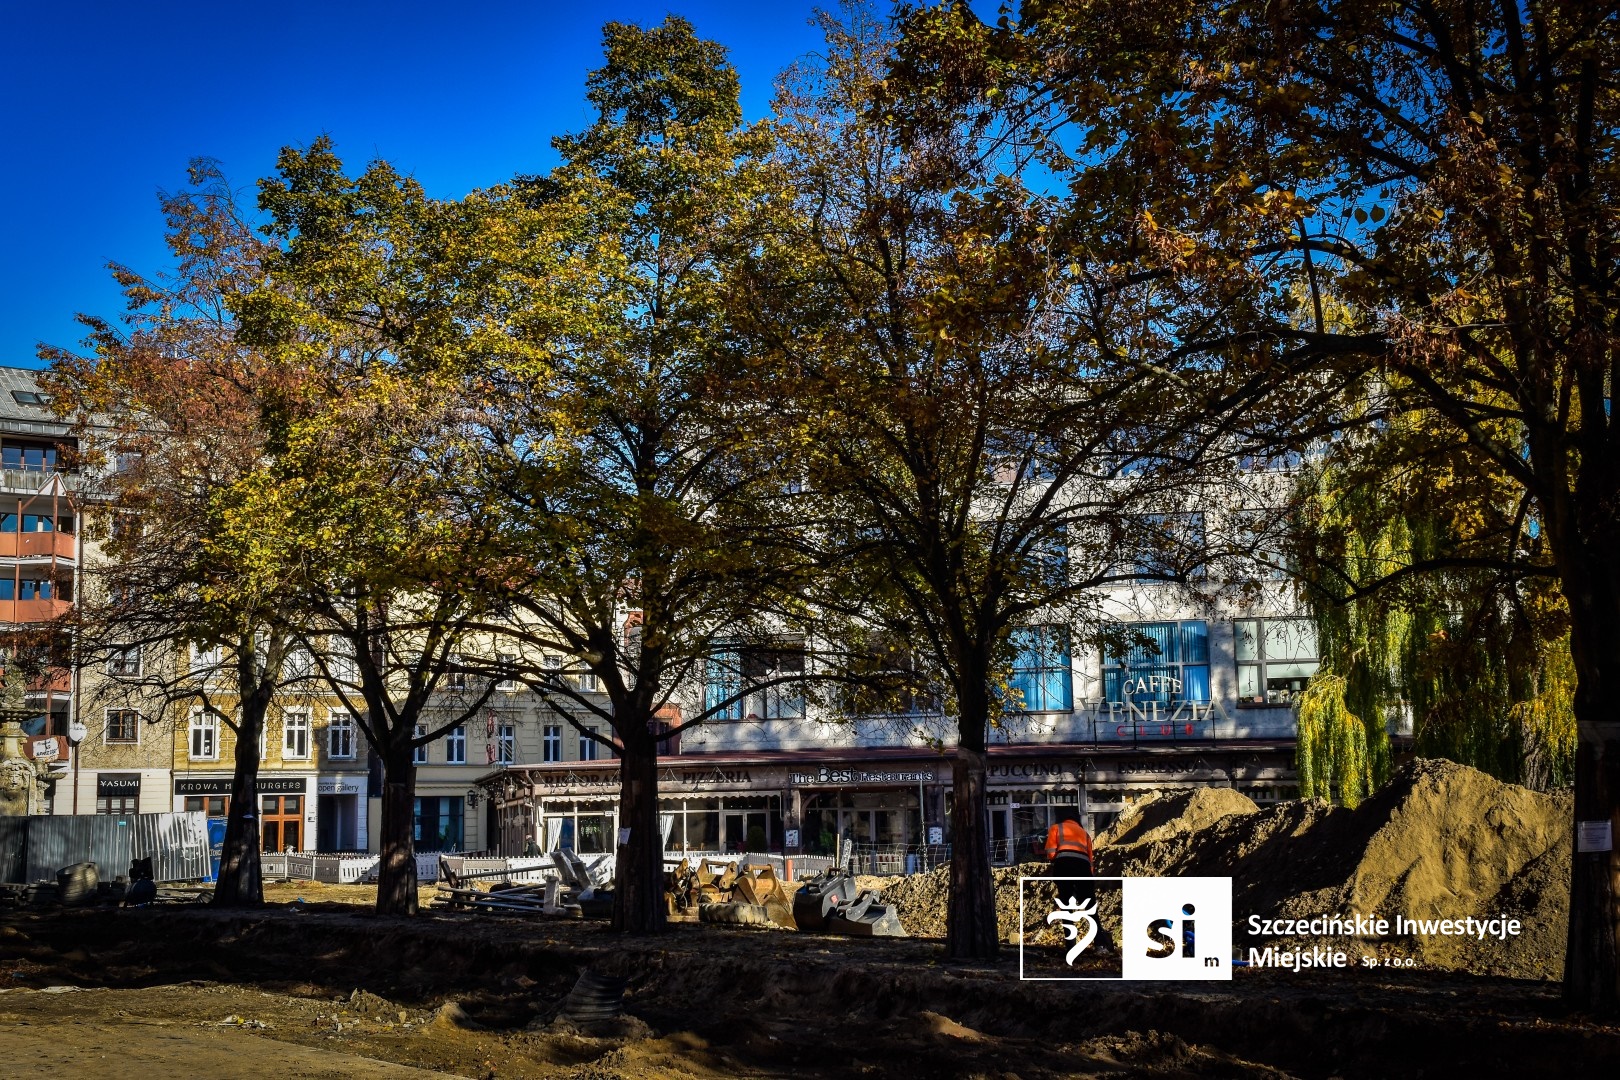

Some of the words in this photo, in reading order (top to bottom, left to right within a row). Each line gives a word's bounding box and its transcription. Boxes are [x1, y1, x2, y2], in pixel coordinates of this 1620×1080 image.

[1122, 675, 1182, 695] CAFFE
[1077, 697, 1231, 723] VENEZIA
[1117, 723, 1194, 737] CLUB
[983, 763, 1061, 777] PUCCINO
[1117, 759, 1199, 774] ESPRESSO
[682, 770, 752, 784] PIZZERIA
[789, 772, 815, 784] The
[816, 765, 858, 784] Best
[859, 771, 934, 782] Restaurants
[180, 783, 218, 791] KROWA
[318, 785, 335, 793] open
[336, 784, 359, 793] gallery
